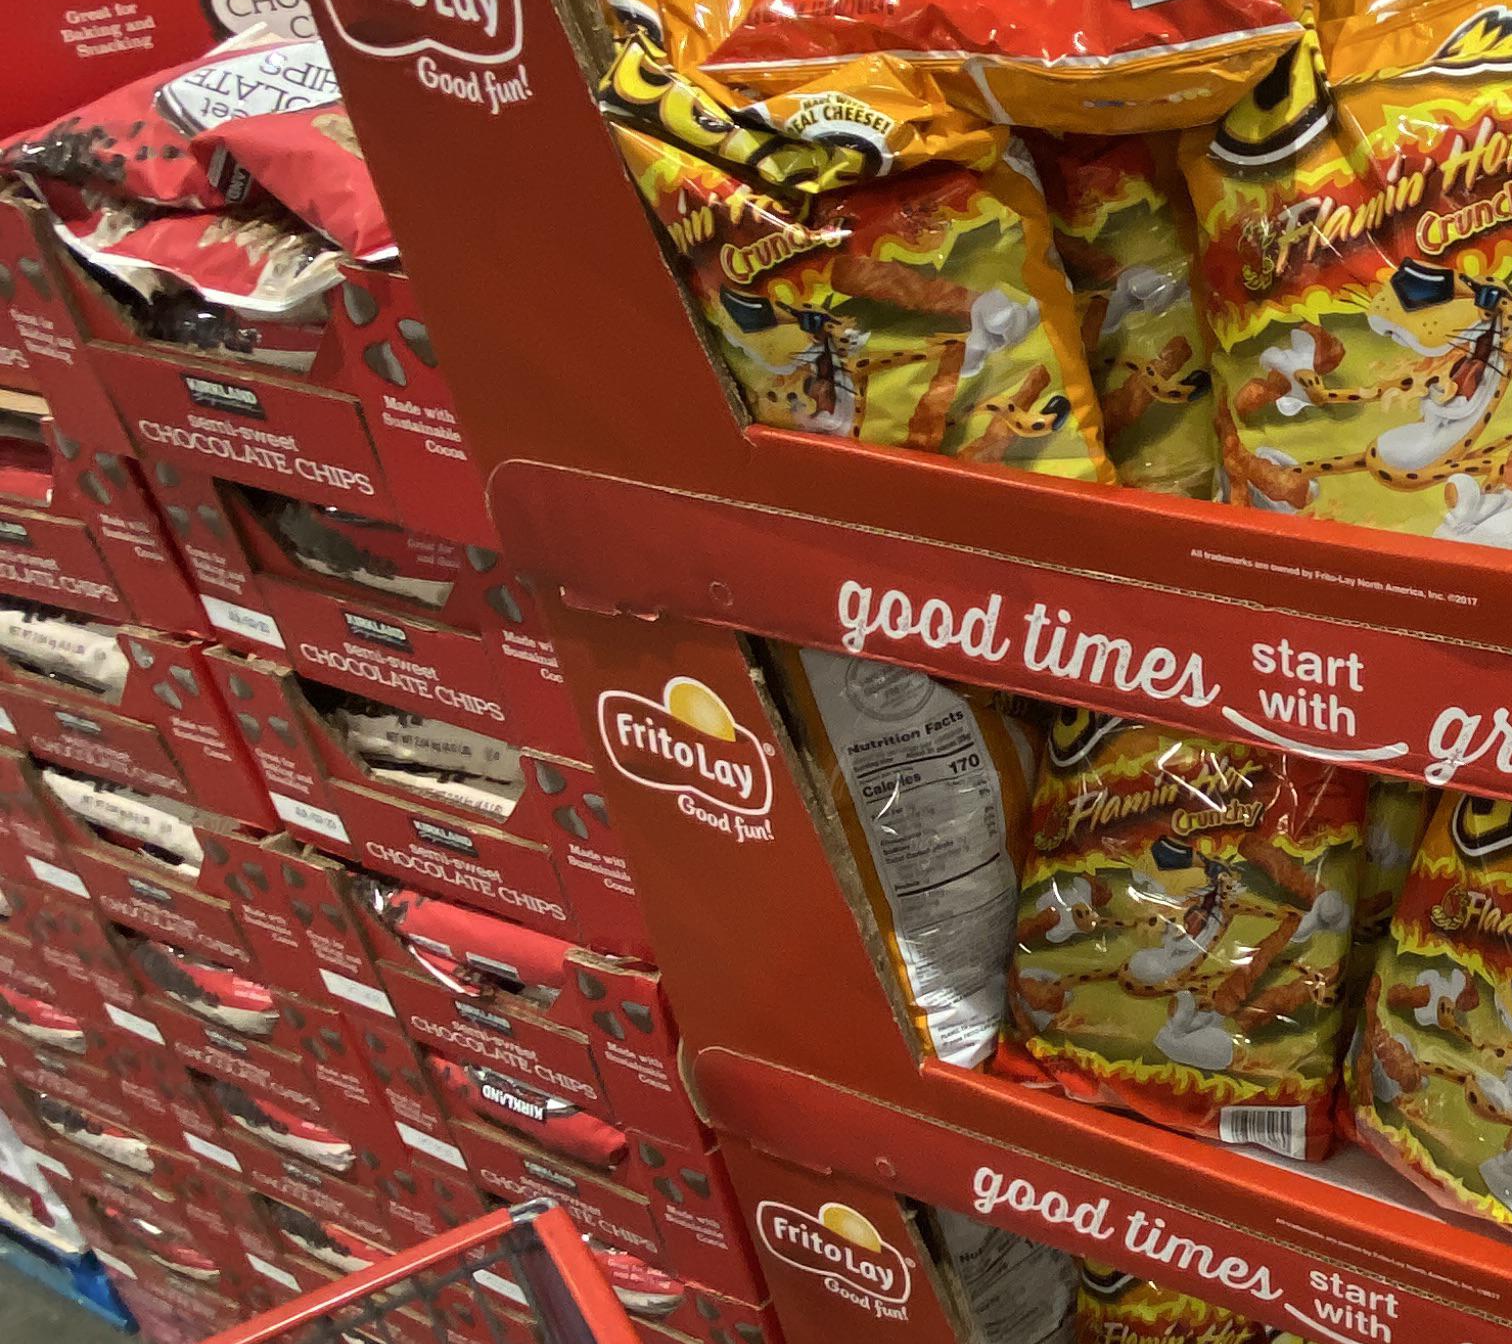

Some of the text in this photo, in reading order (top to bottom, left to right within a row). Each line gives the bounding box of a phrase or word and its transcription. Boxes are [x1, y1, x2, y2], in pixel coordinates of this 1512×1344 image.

[125, 16, 156, 32] and
[258, 51, 340, 94] HIPS
[416, 56, 533, 115] Good fun!
[822, 105, 892, 135] CHEESE!
[382, 395, 457, 425] Made with
[138, 419, 375, 496] CHOCOLATE CHIPS
[1301, 568, 1313, 580] by
[1356, 577, 1384, 591] North
[837, 578, 1221, 708] good times
[1251, 638, 1365, 692] start
[299, 642, 506, 723] CHOCOLATE CHIPS
[847, 708, 965, 756] Nutrition Facts
[1258, 686, 1358, 739] with
[947, 752, 981, 776] 170
[676, 794, 775, 844] Good fun!
[366, 841, 567, 921] CHOCOLATE CHIPS
[482, 1084, 544, 1121] KIRKLAND
[534, 1064, 598, 1100] CHIPS
[971, 1164, 1114, 1242] good
[1125, 1210, 1285, 1302] times
[823, 1275, 872, 1314] Good
[1308, 1267, 1401, 1320] start
